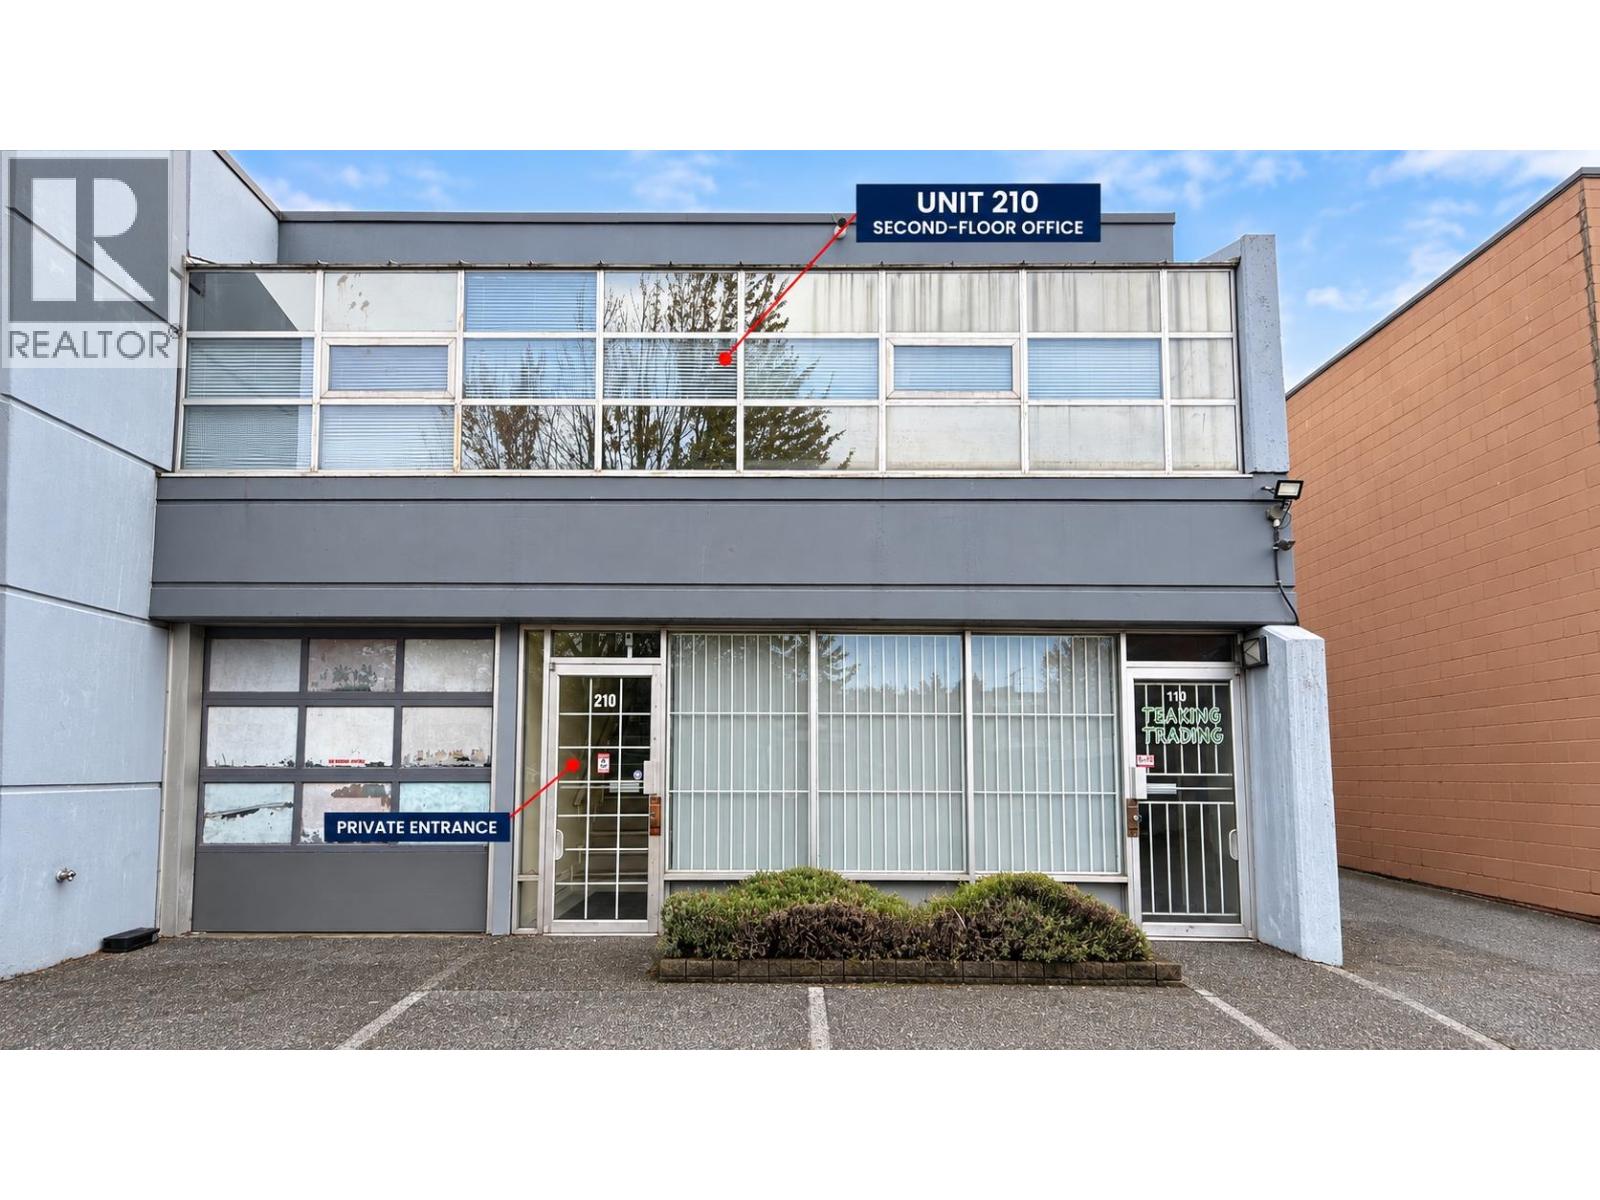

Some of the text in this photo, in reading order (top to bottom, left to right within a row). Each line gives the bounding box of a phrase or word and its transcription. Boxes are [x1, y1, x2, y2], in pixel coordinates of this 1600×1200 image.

[593, 693, 616, 708] 210
[1167, 690, 1187, 702] 110
[1141, 706, 1222, 725] TEAKING
[1141, 726, 1224, 745] TRADING
